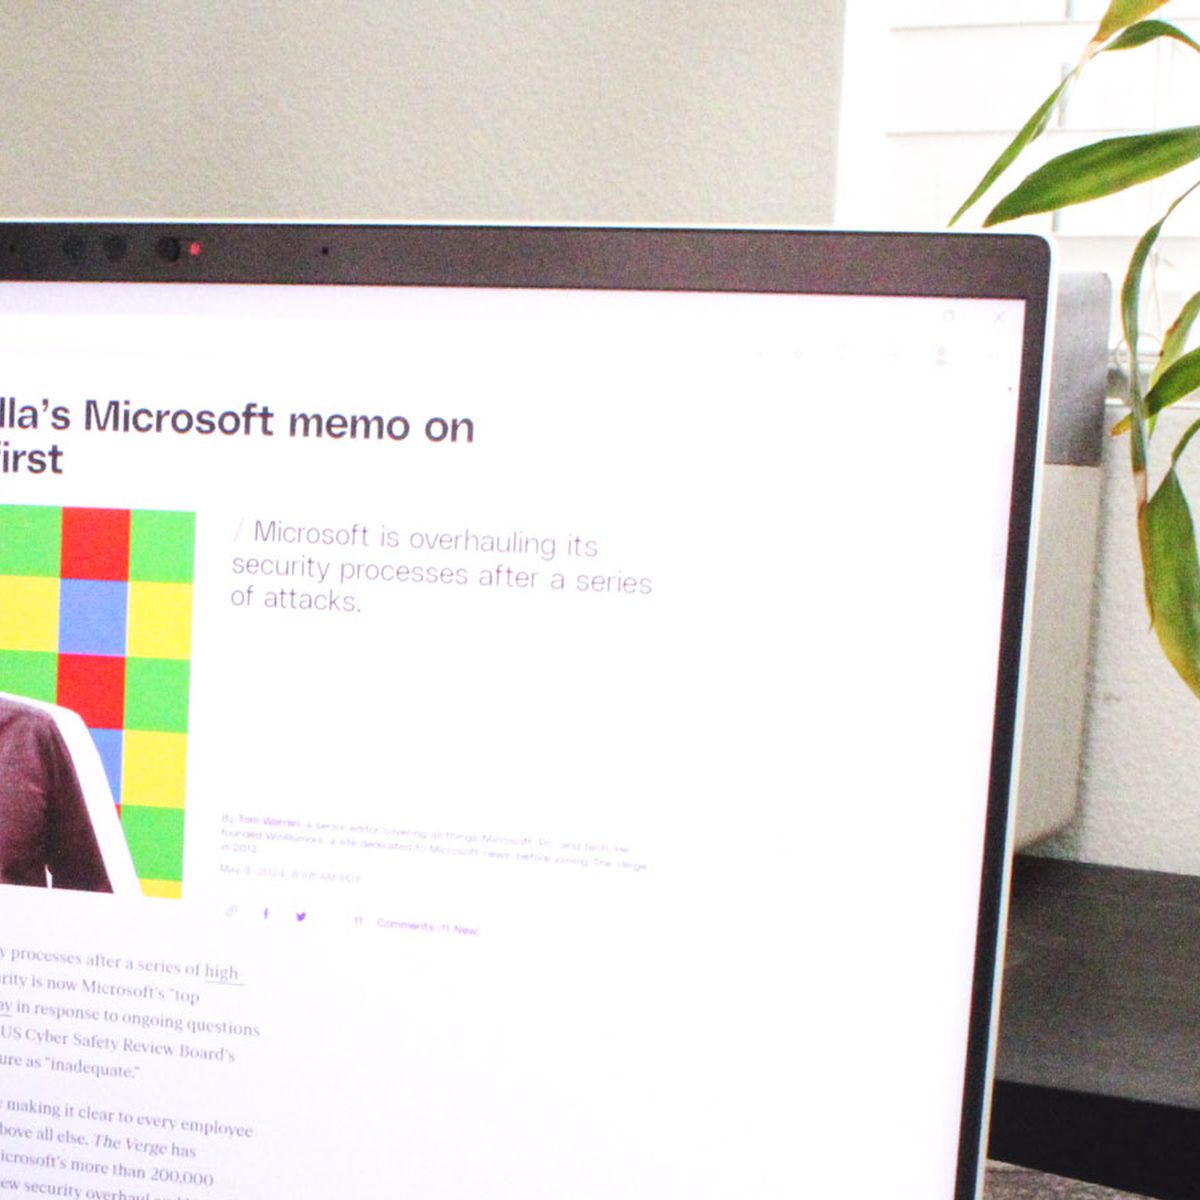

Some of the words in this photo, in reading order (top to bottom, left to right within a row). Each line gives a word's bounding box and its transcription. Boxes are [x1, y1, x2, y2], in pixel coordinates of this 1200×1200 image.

[84, 399, 274, 436] Microsoft
[289, 413, 410, 441] memo
[424, 416, 474, 443] on
[254, 519, 369, 547] Microsoft
[380, 524, 399, 548] is
[409, 528, 556, 562] overhauling
[567, 535, 598, 558] its
[232, 554, 330, 584] security
[340, 562, 468, 585] processes
[478, 563, 539, 588] after
[549, 572, 565, 590] a
[576, 573, 652, 595] series
[230, 584, 254, 607] of
[264, 587, 361, 613] attacks.
[10, 948, 82, 965] processes
[86, 953, 121, 969] after
[124, 959, 134, 970] a
[137, 960, 181, 974] series
[184, 963, 200, 977] of
[204, 963, 238, 983] high
[31, 974, 43, 988] is
[47, 978, 77, 991] now
[16, 1000, 30, 1014] in
[33, 1004, 99, 1021] response
[103, 1010, 119, 1022] to
[121, 1014, 183, 1032] ongoing
[186, 1020, 260, 1037] questions
[0, 1024, 22, 1040] US
[24, 1028, 68, 1045] Cyber
[73, 1033, 117, 1051] Safety
[122, 1037, 173, 1056] Review
[25, 1057, 41, 1068] as
[6, 1098, 61, 1119] making
[64, 1104, 74, 1118] it
[77, 1105, 115, 1123] clear
[118, 1111, 134, 1124] to
[136, 1115, 175, 1130] every
[180, 1119, 253, 1138] employee
[36, 1127, 53, 1142] all
[56, 1129, 88, 1145] else.
[94, 1133, 121, 1150] The
[126, 1137, 167, 1156] Verge
[170, 1141, 196, 1158] has
[70, 1160, 108, 1175] more
[112, 1162, 145, 1179] than
[150, 1167, 214, 1187] 200,000
[23, 1182, 80, 1200] security
